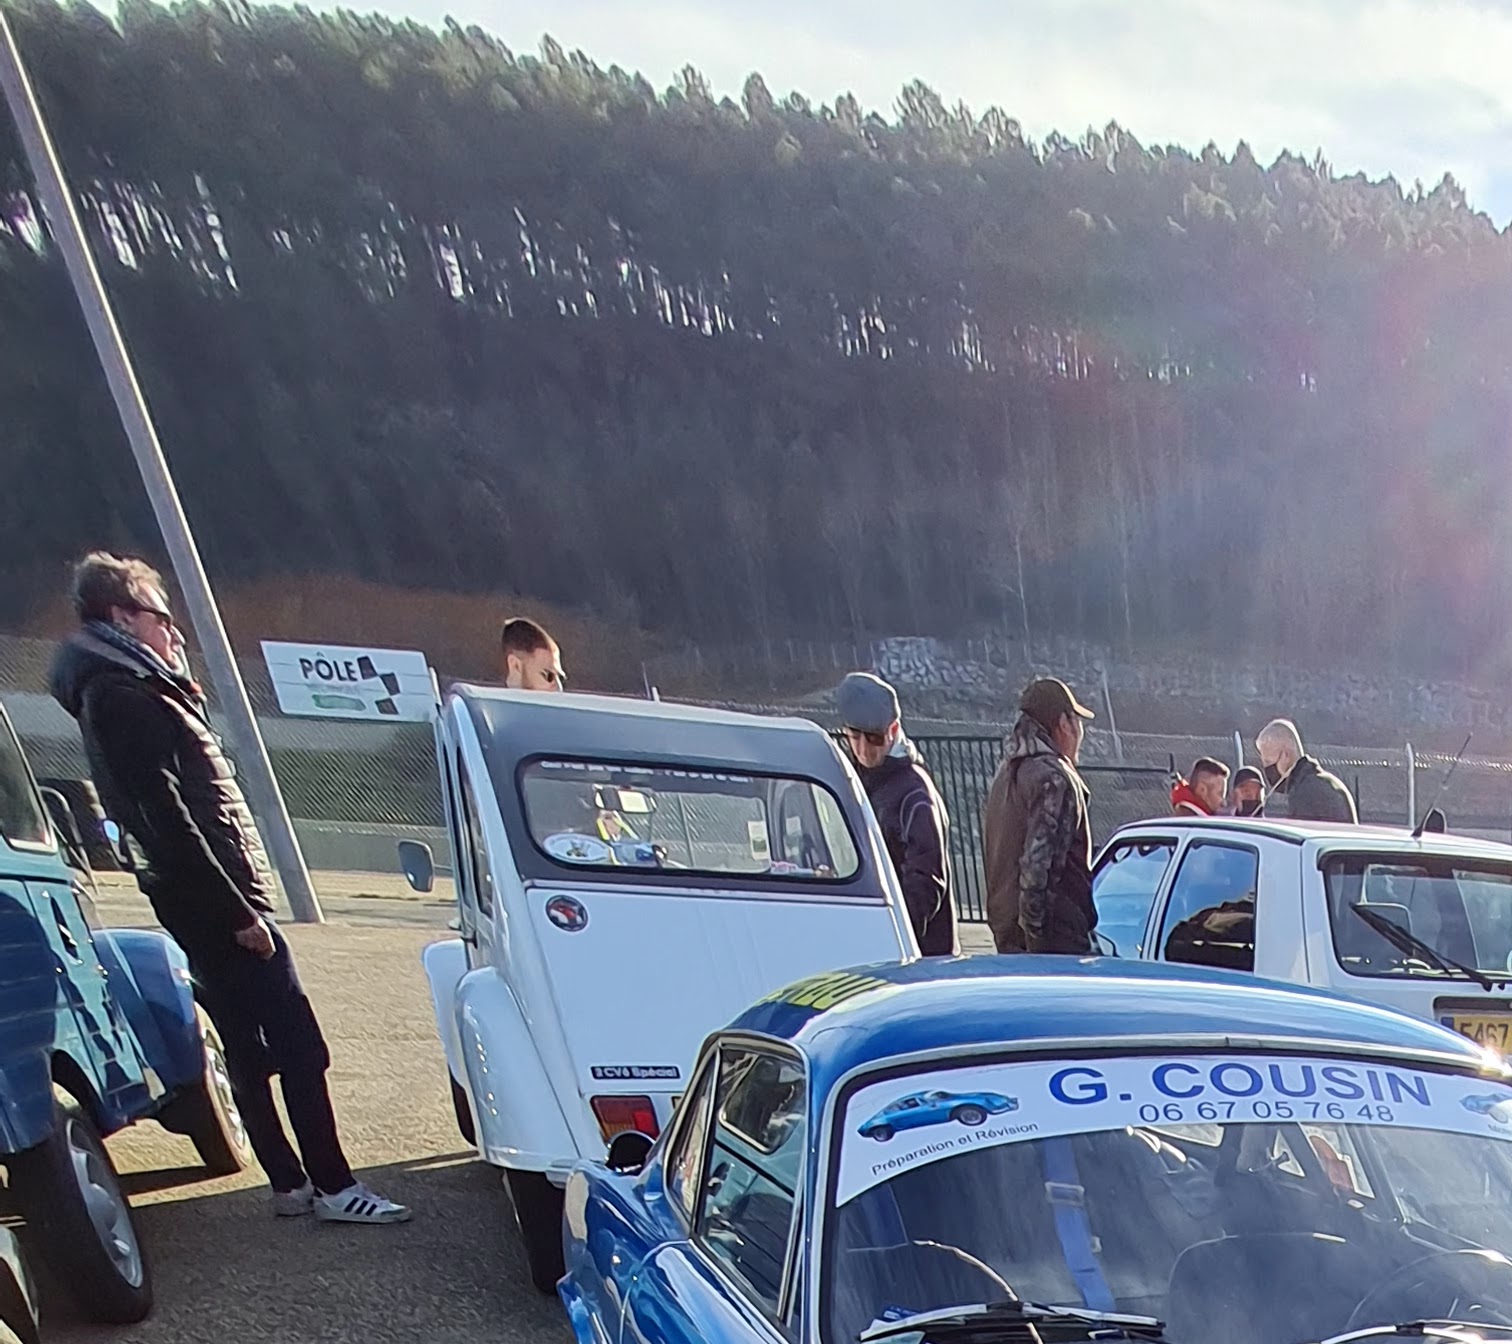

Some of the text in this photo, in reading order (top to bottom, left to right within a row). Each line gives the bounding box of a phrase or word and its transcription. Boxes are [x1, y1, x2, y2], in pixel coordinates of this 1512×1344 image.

[299, 652, 358, 682] PÔLE
[1048, 1062, 1432, 1107] G. COUSIN
[1139, 1100, 1395, 1122] 06 67 05 76 48
[872, 1122, 1039, 1176] Préparation et Révision
